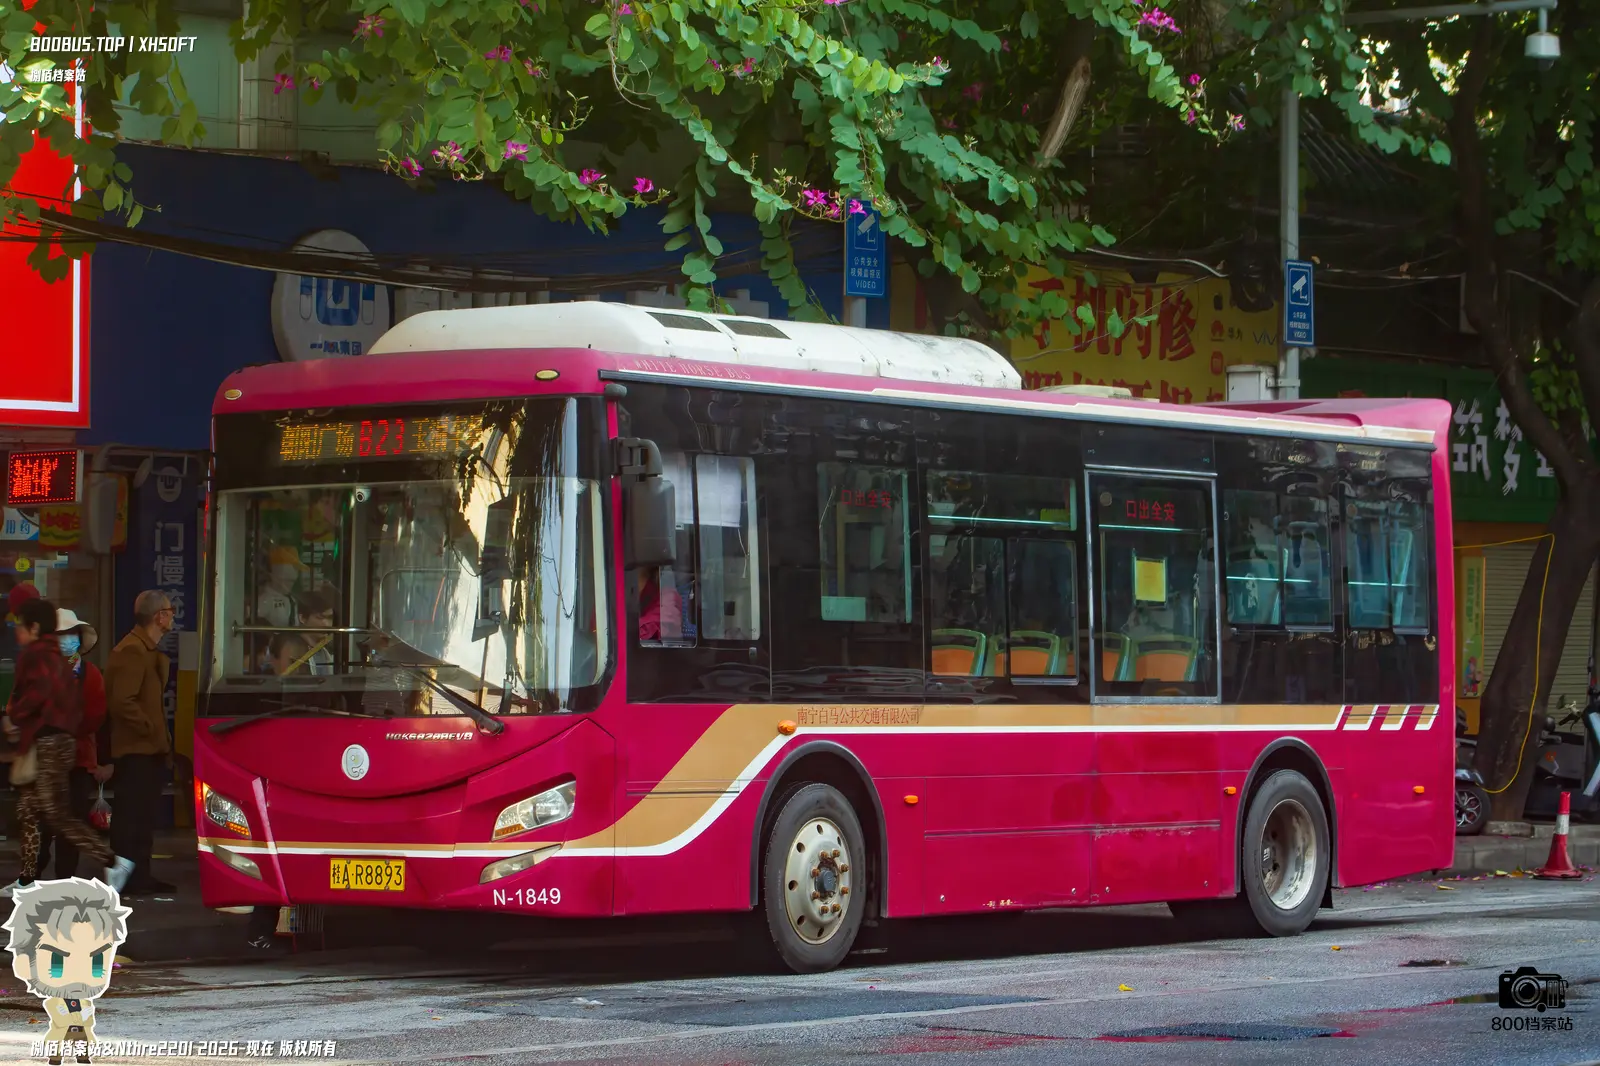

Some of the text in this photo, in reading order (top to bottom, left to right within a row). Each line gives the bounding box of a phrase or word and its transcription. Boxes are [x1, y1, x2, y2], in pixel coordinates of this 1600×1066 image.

[855, 280, 876, 289] VIDEO
[633, 359, 677, 373] WHITE
[679, 362, 723, 377] HORSE
[358, 418, 405, 457] B23
[797, 706, 920, 725] 南宁白马公共交通有限公司
[493, 887, 561, 906] N-1849
